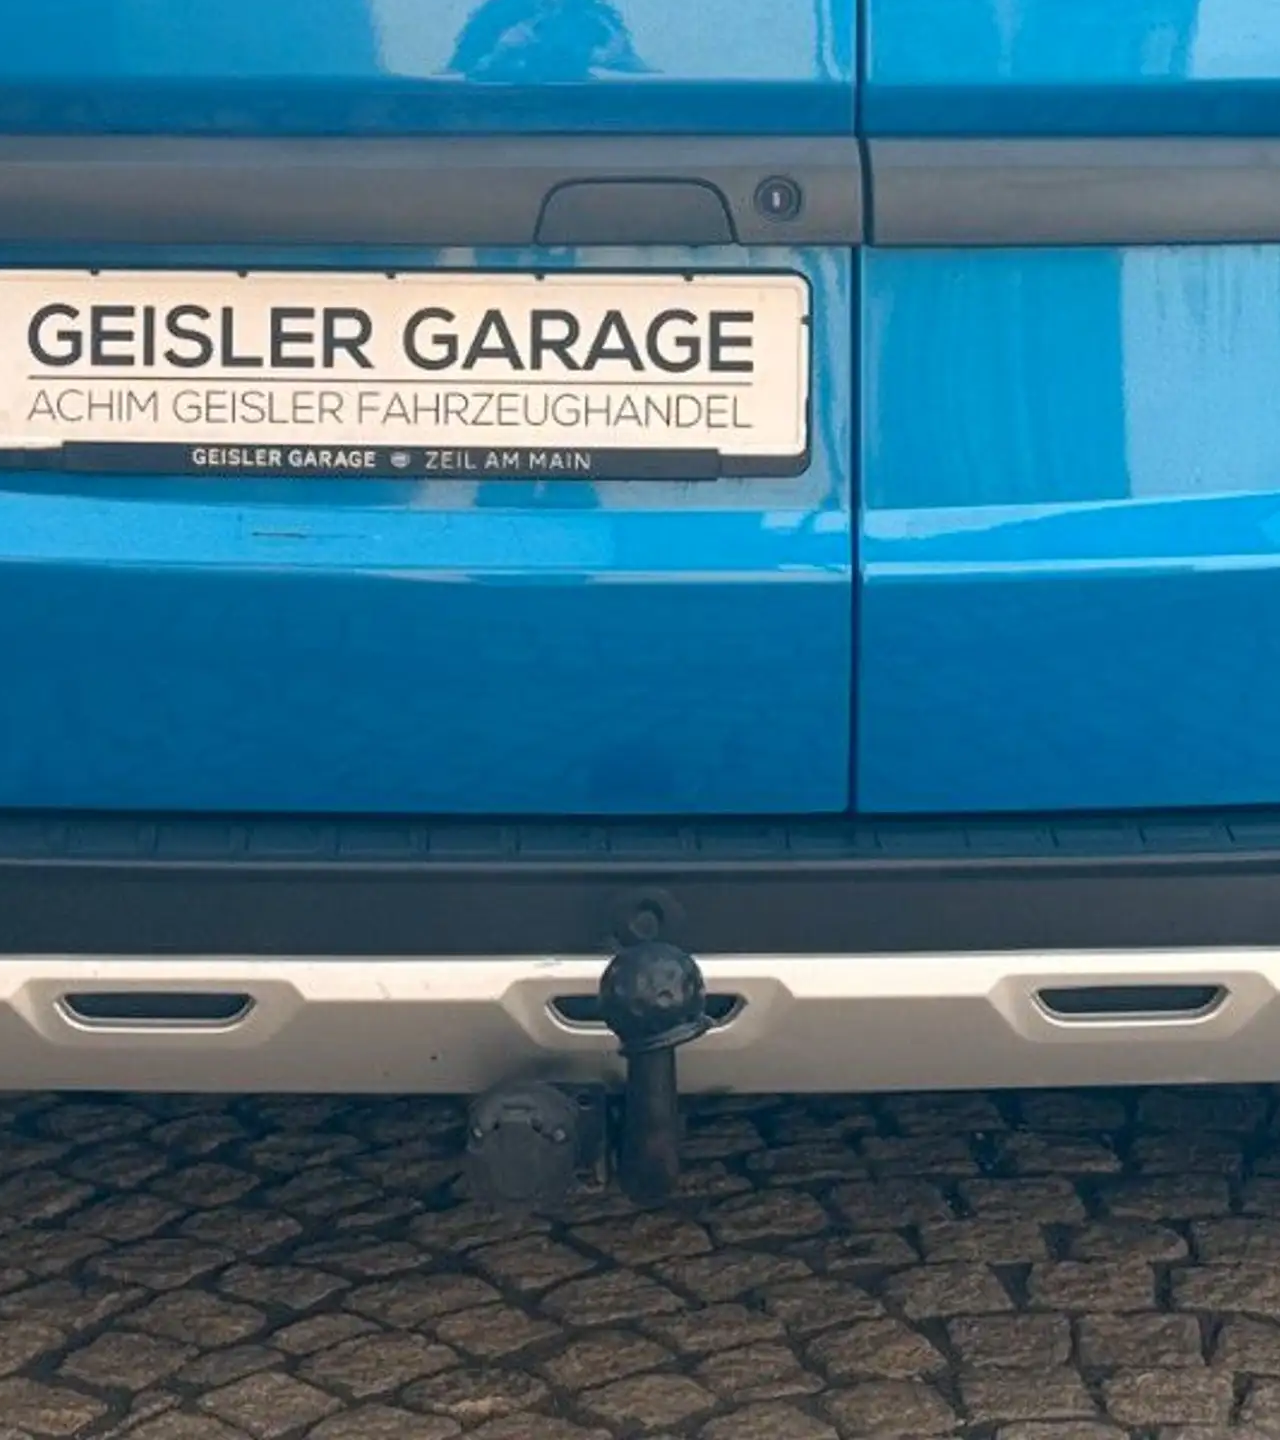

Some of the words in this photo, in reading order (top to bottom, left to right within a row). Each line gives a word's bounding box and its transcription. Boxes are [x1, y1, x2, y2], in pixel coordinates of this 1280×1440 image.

[28, 303, 374, 368] GEISLER
[403, 307, 754, 373] GARAGE
[27, 388, 160, 422] ACHIM
[172, 389, 345, 425] GEISLER
[357, 390, 754, 429] FAHRZEUGHANDEL
[192, 448, 282, 466] GEISLER
[287, 450, 376, 468] GARAGE
[424, 451, 477, 470] ZEIL
[483, 451, 520, 469] AM
[528, 452, 591, 471] MAIN
